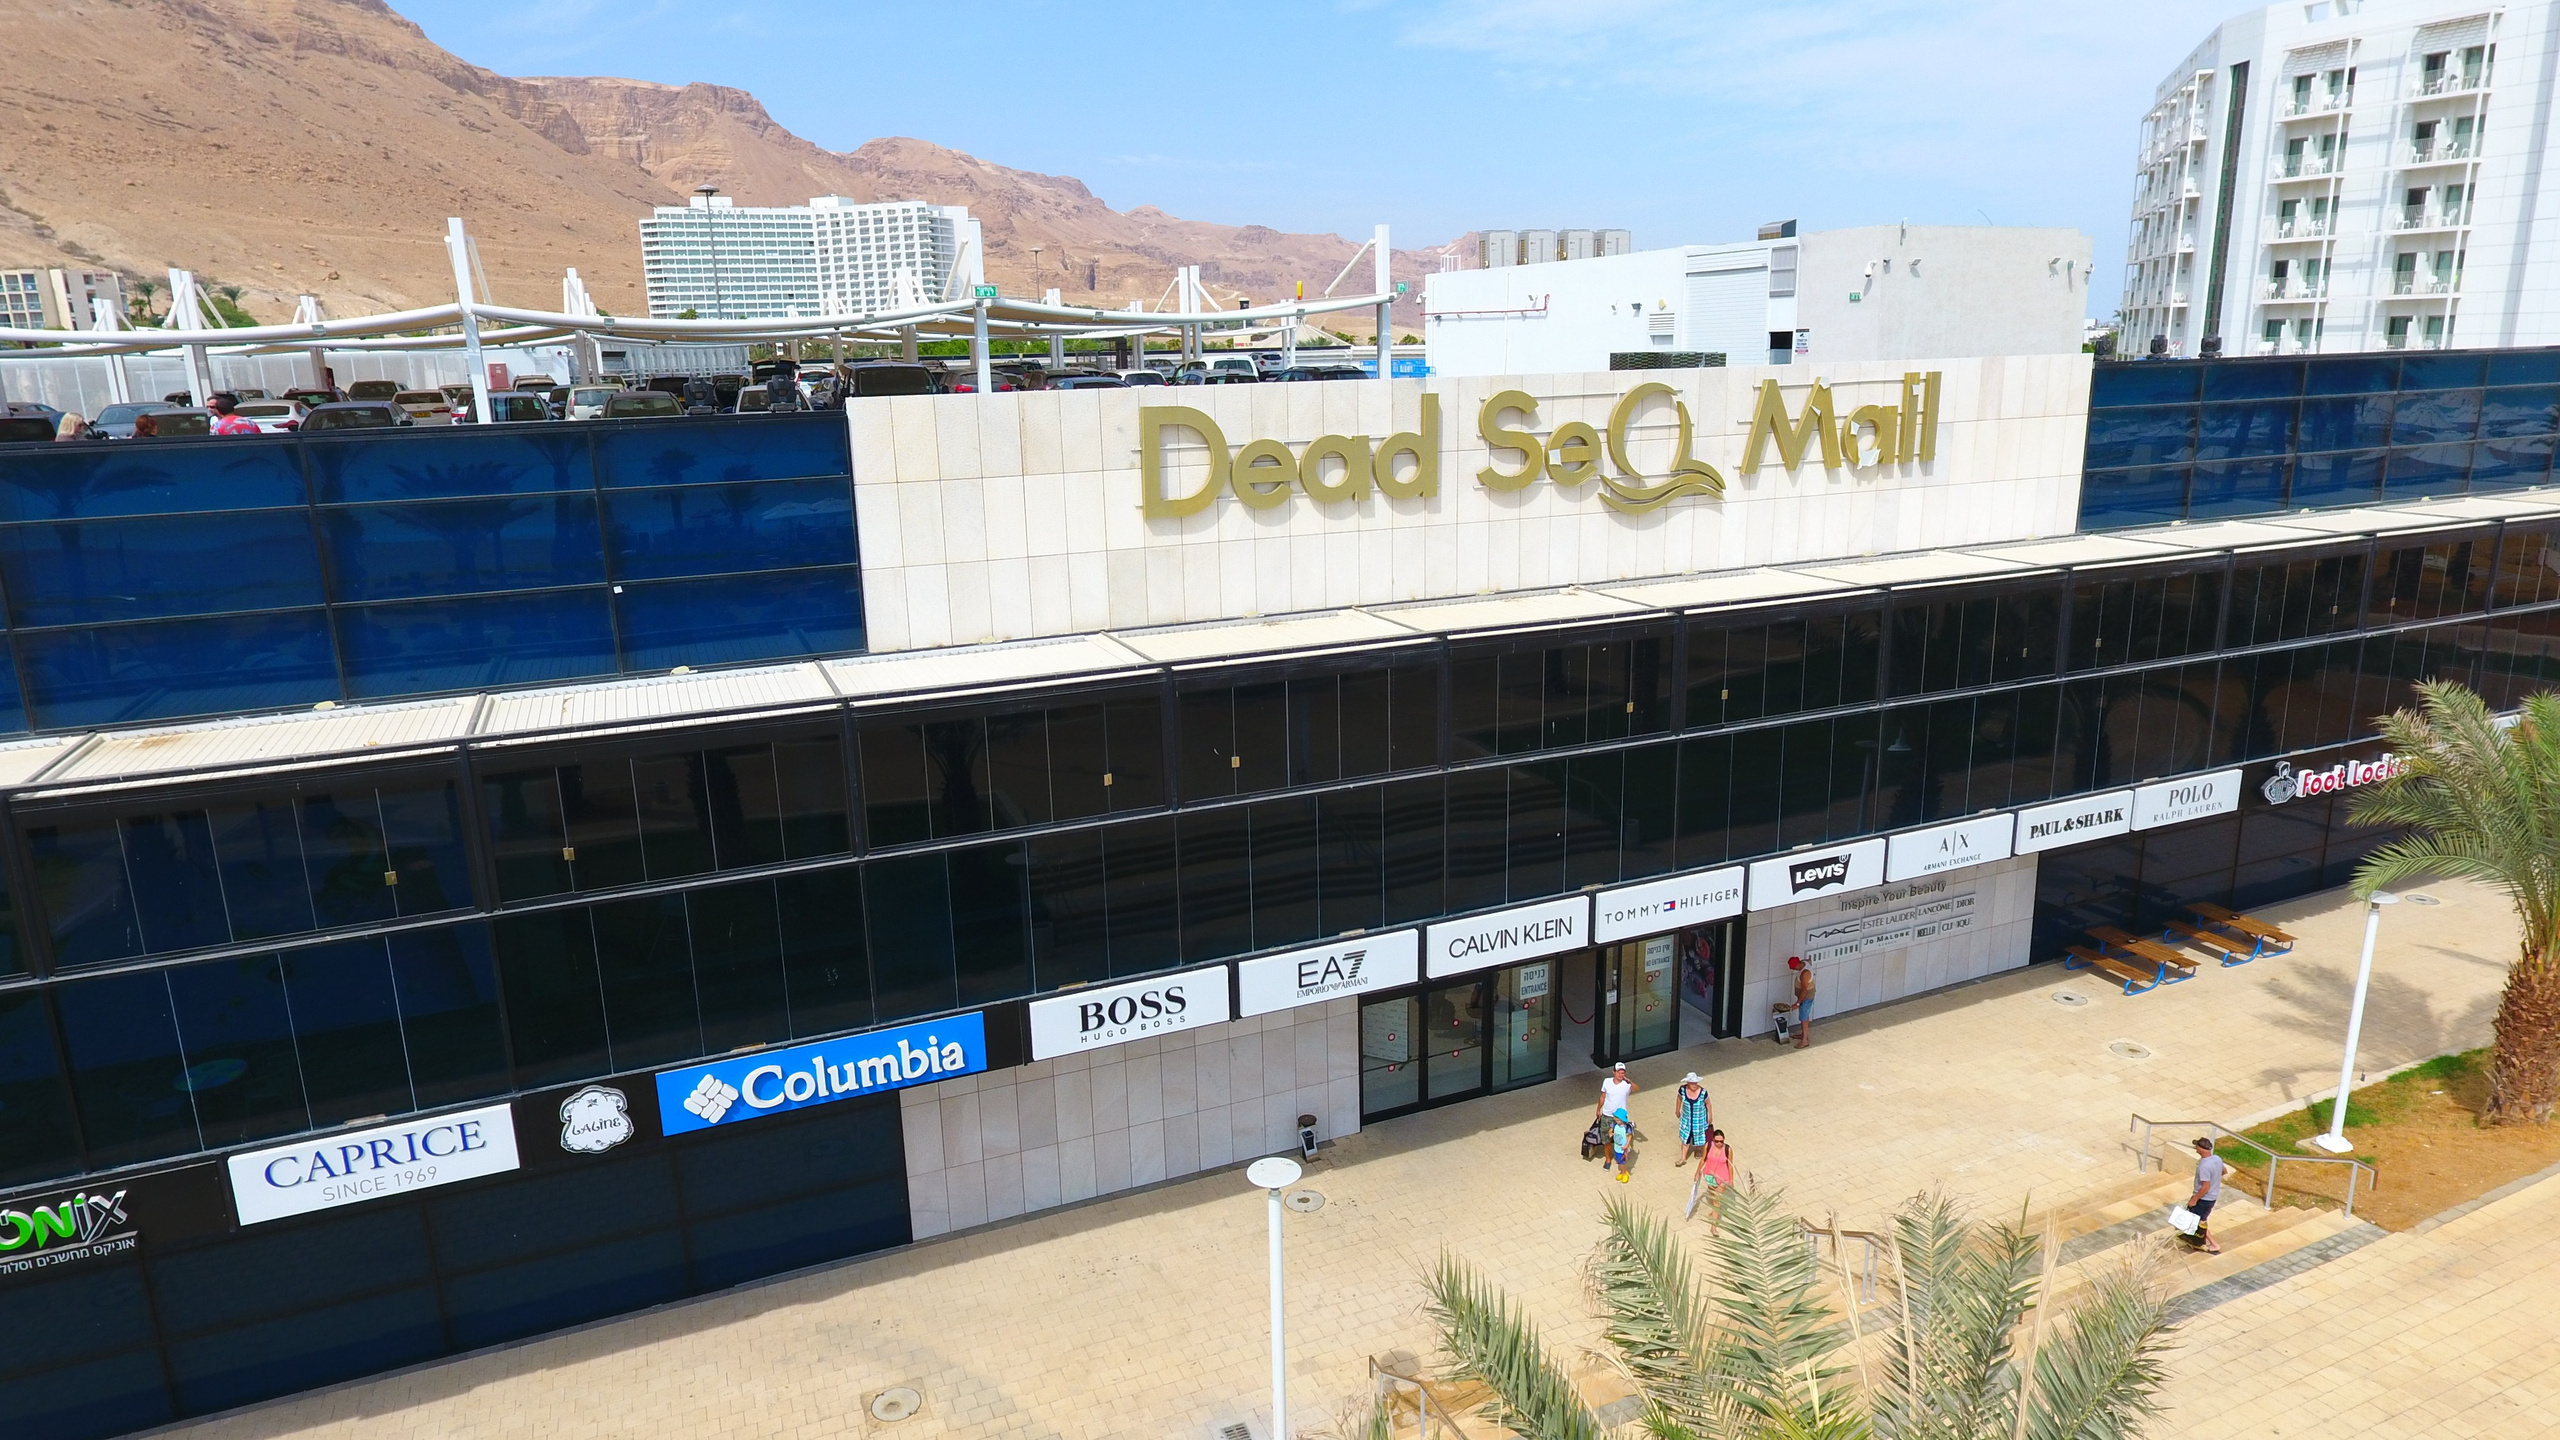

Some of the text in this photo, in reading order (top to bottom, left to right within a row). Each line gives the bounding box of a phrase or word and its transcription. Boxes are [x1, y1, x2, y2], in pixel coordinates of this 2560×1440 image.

[1142, 371, 1942, 521] Dead Sea Mall
[2297, 765, 2345, 797] Foot
[2168, 782, 2214, 807] POLO
[2153, 801, 2223, 823] RALPH LAUREN
[1923, 853, 1982, 872] ARMANI EXCHANGE
[1604, 888, 1740, 924] TOMMY HILFIGER
[1841, 881, 1947, 911] Inspire Your Beauty
[1918, 901, 1952, 916] LANCÔME
[1956, 898, 1975, 909] DIOR
[1885, 911, 1916, 925] LAUDER
[1449, 916, 1572, 958] CALVIN KLEIN
[1298, 950, 1367, 989] EA7
[1524, 969, 1545, 982] כניסה
[1296, 976, 1368, 999] EMPORIO ARMANI
[1521, 981, 1548, 996] ENTRANCE
[1078, 986, 1187, 1033] BOSS
[1080, 1015, 1186, 1043] HUGO BOSS
[741, 1035, 966, 1109] Columbia
[264, 1120, 487, 1189] CAPRICE
[322, 1165, 438, 1202] SINCE 1969
[36, 1248, 90, 1267] מחשבים
[93, 1238, 136, 1256] אוניקס
